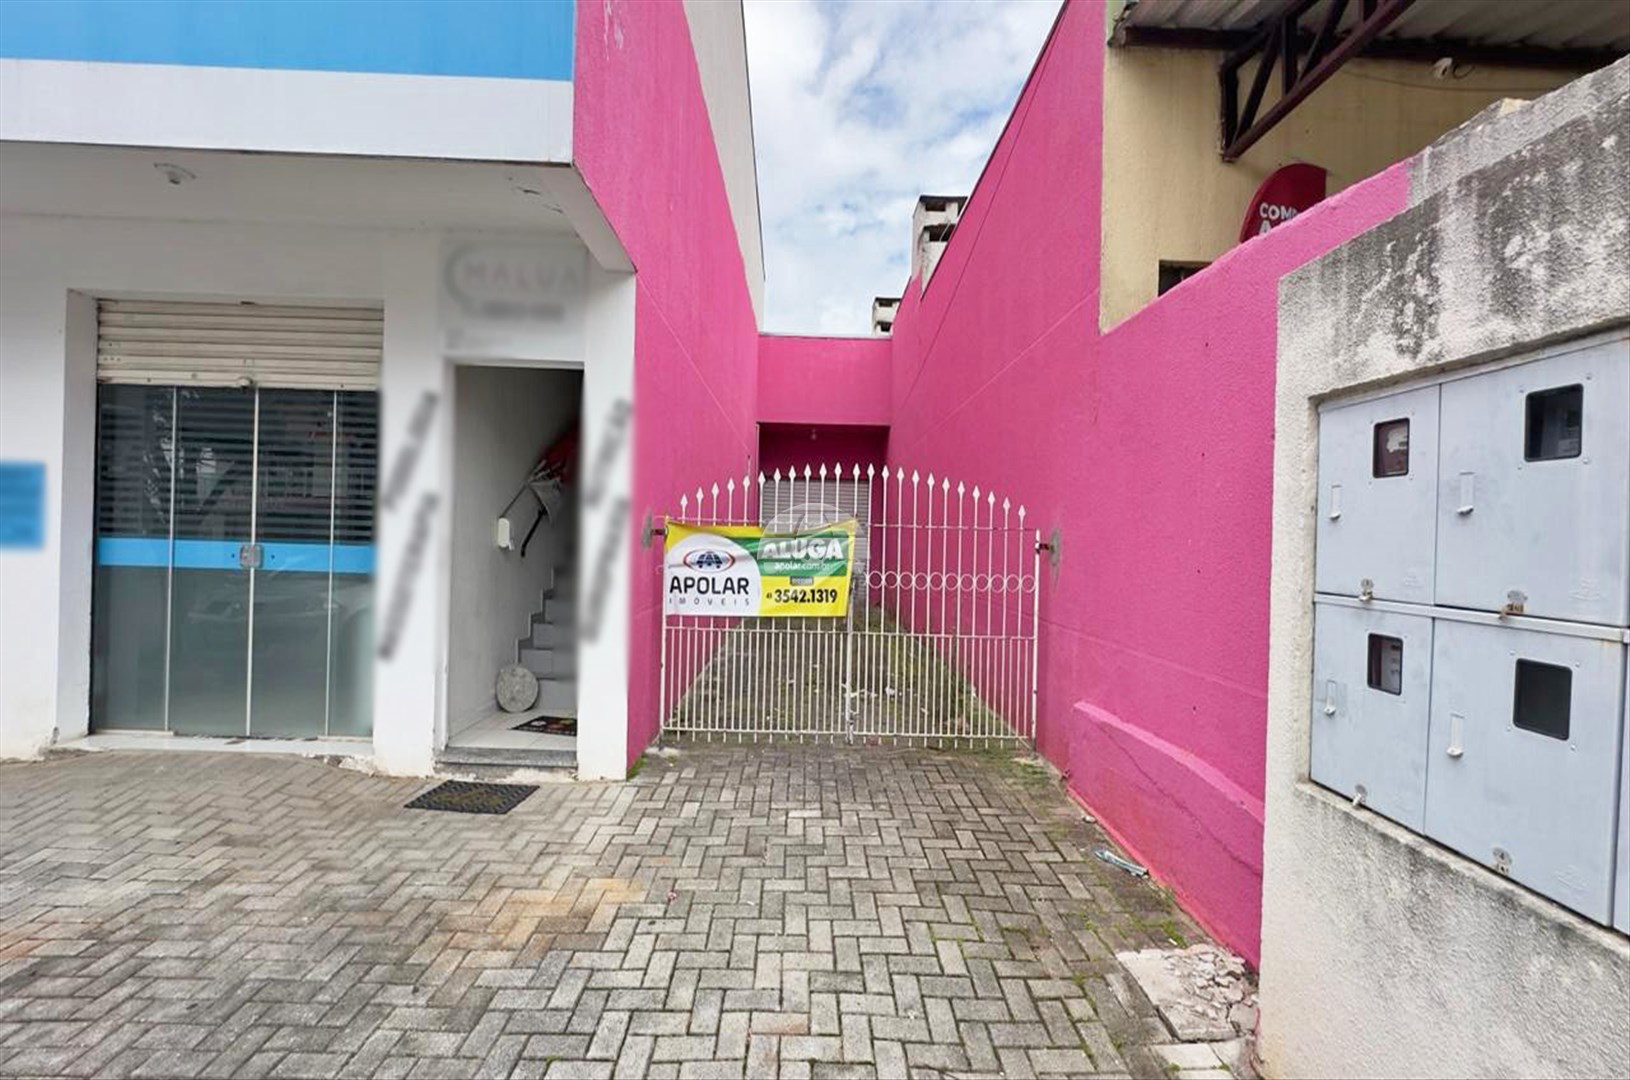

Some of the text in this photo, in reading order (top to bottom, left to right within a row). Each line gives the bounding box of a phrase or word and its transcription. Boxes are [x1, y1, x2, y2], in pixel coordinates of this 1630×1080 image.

[761, 538, 844, 560] ALUGA
[669, 576, 750, 595] APOLAR
[774, 589, 838, 603] 3542.1319
